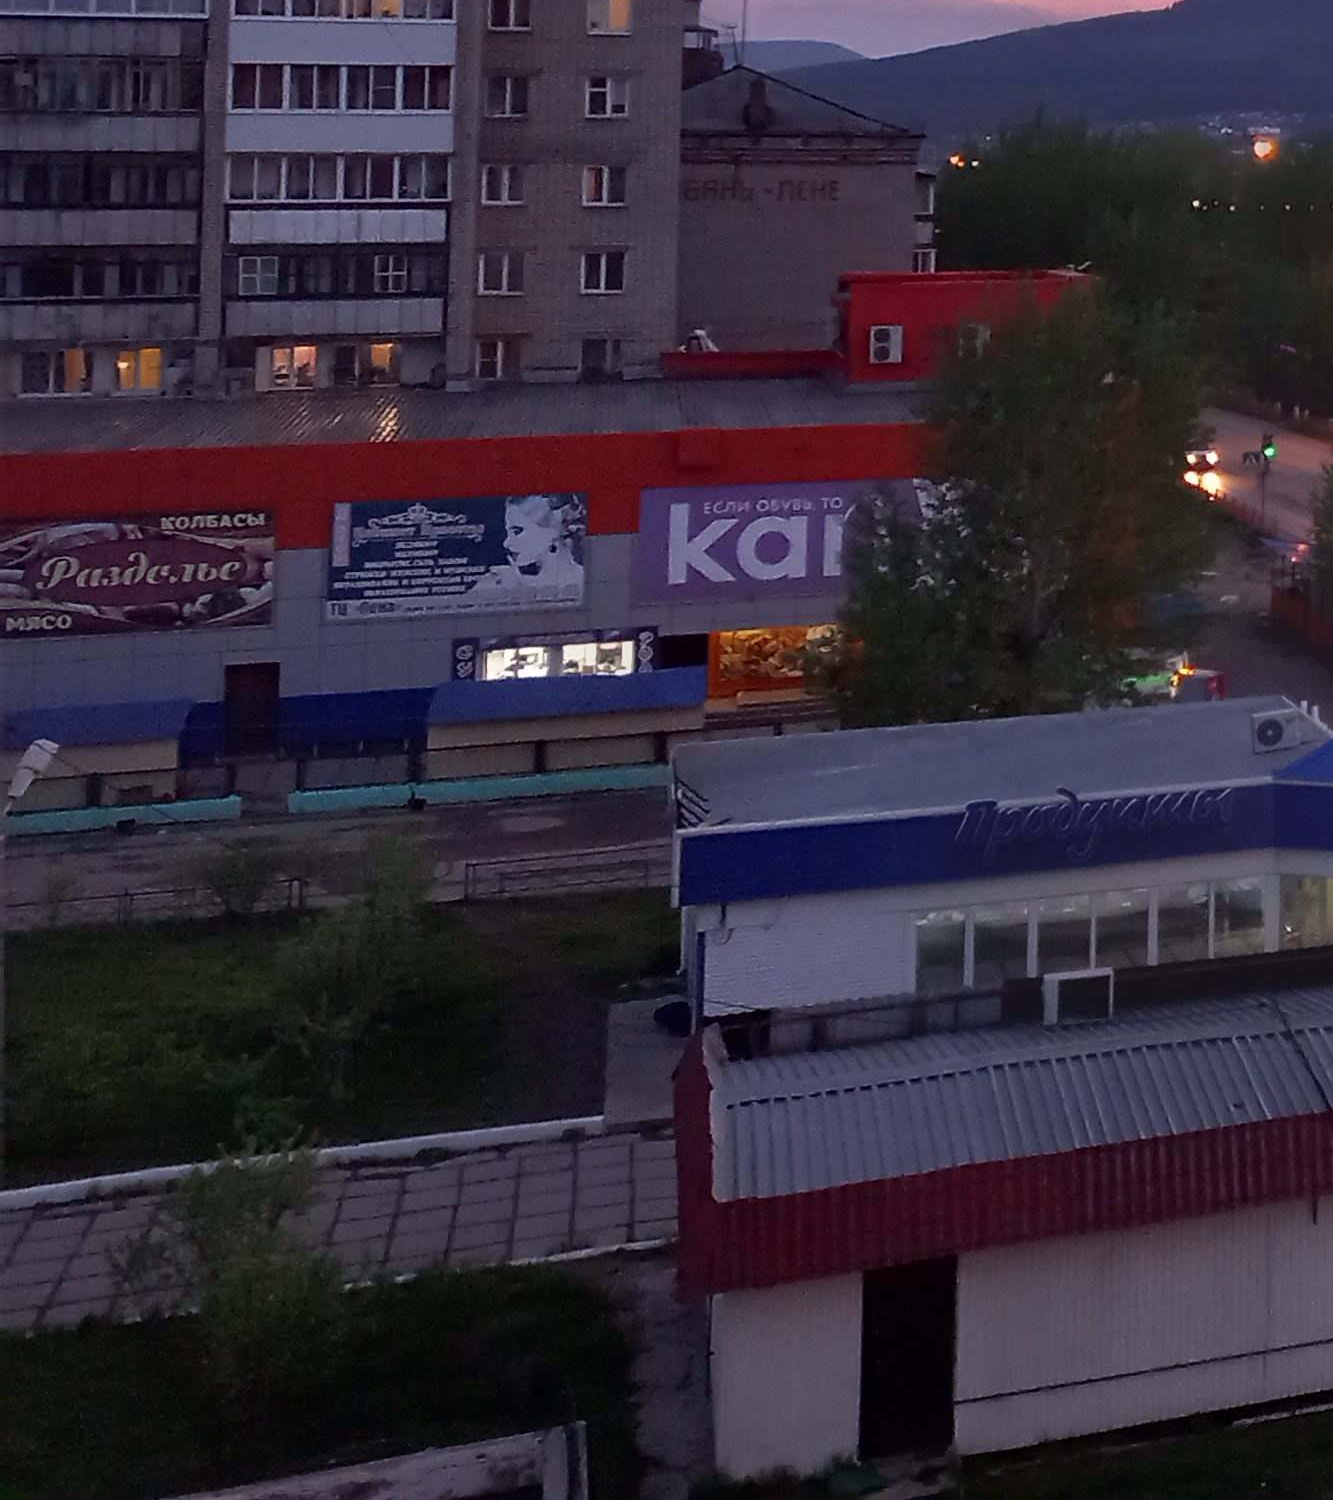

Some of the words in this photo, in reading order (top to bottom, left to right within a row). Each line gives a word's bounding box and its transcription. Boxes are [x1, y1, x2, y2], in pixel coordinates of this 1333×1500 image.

[703, 501, 750, 515] ЕСЛИ
[820, 497, 843, 510] ТО
[160, 513, 266, 531] КОЛБАСЫ
[35, 551, 243, 590] Раздолье
[5, 614, 73, 632] МЯСО
[954, 786, 1234, 867] Продукты
